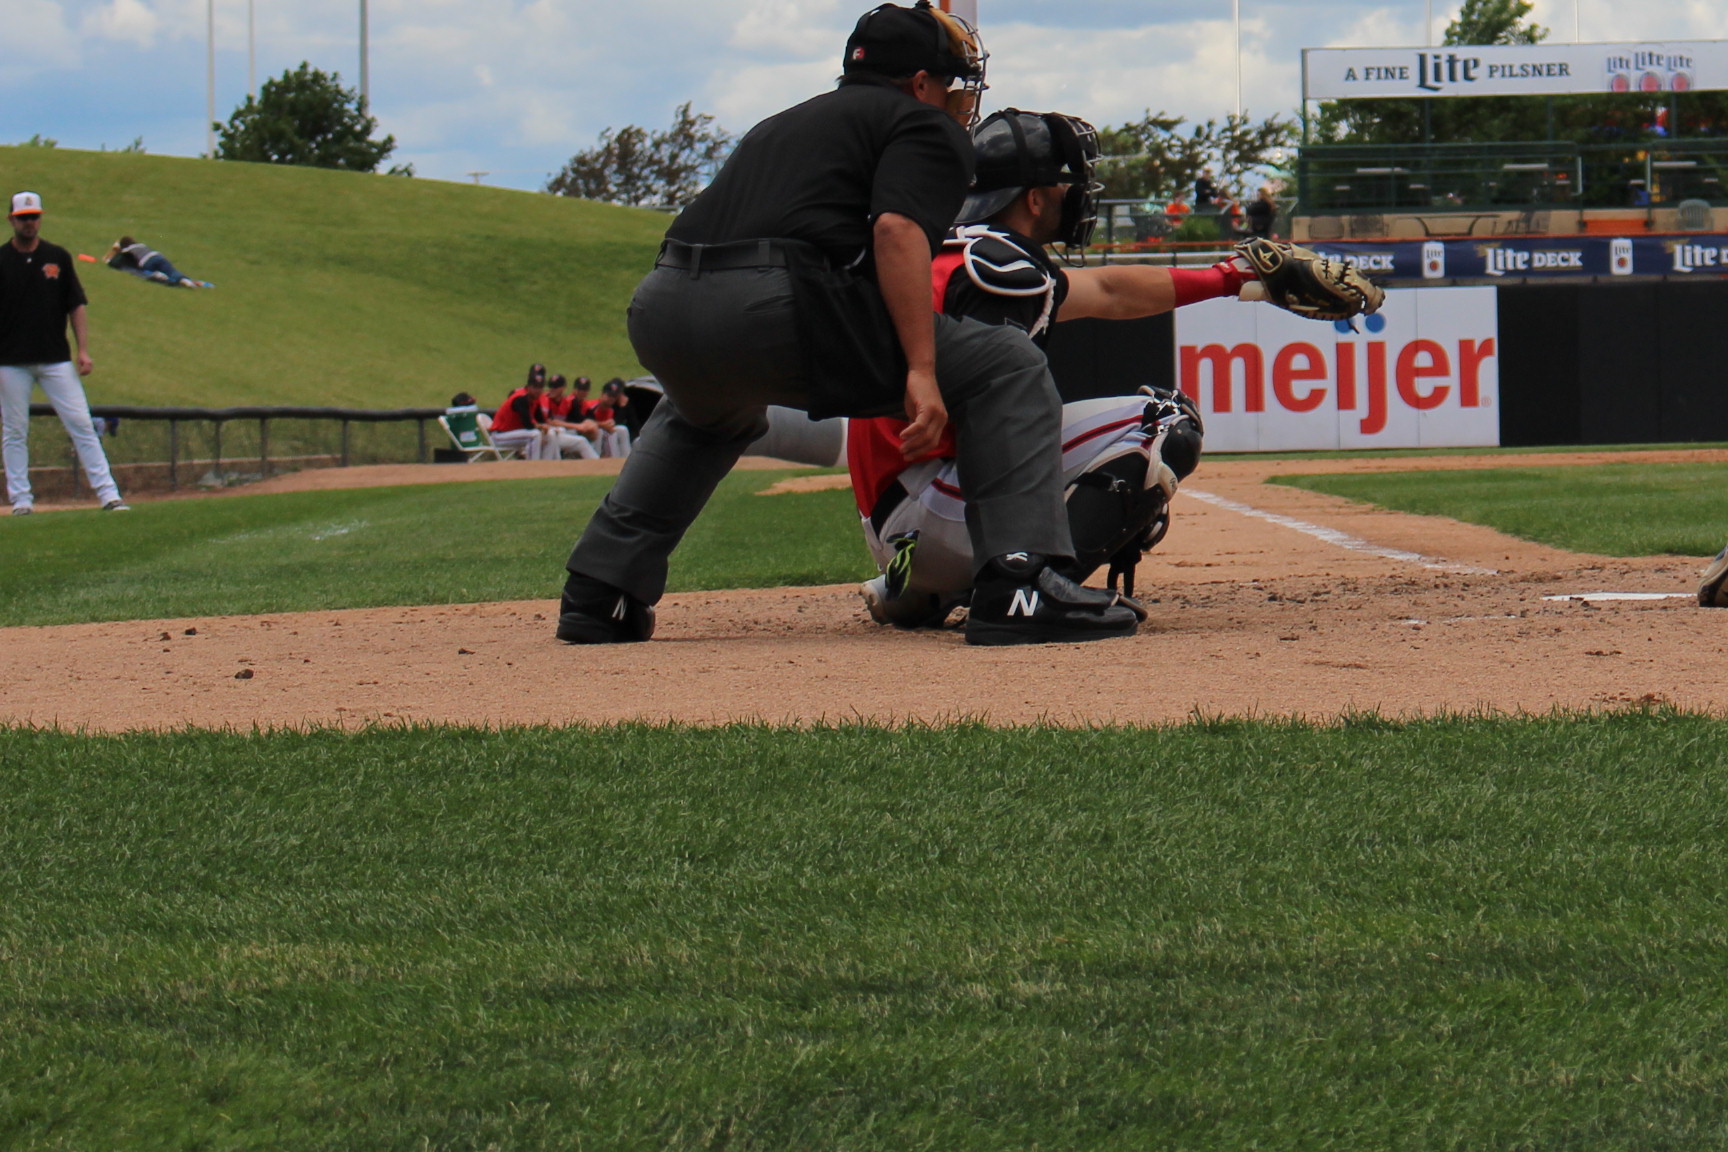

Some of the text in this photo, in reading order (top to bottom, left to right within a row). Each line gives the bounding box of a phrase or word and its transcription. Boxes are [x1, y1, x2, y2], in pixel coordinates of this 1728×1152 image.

[1344, 52, 1572, 92] A FINE Lite PILSNER
[1634, 51, 1664, 71] Lite
[1667, 54, 1693, 72] Lite
[1485, 248, 1583, 276] Lite DECK
[1672, 243, 1717, 273] Lite
[1180, 313, 1496, 436] meijer
[1007, 589, 1039, 617] N
